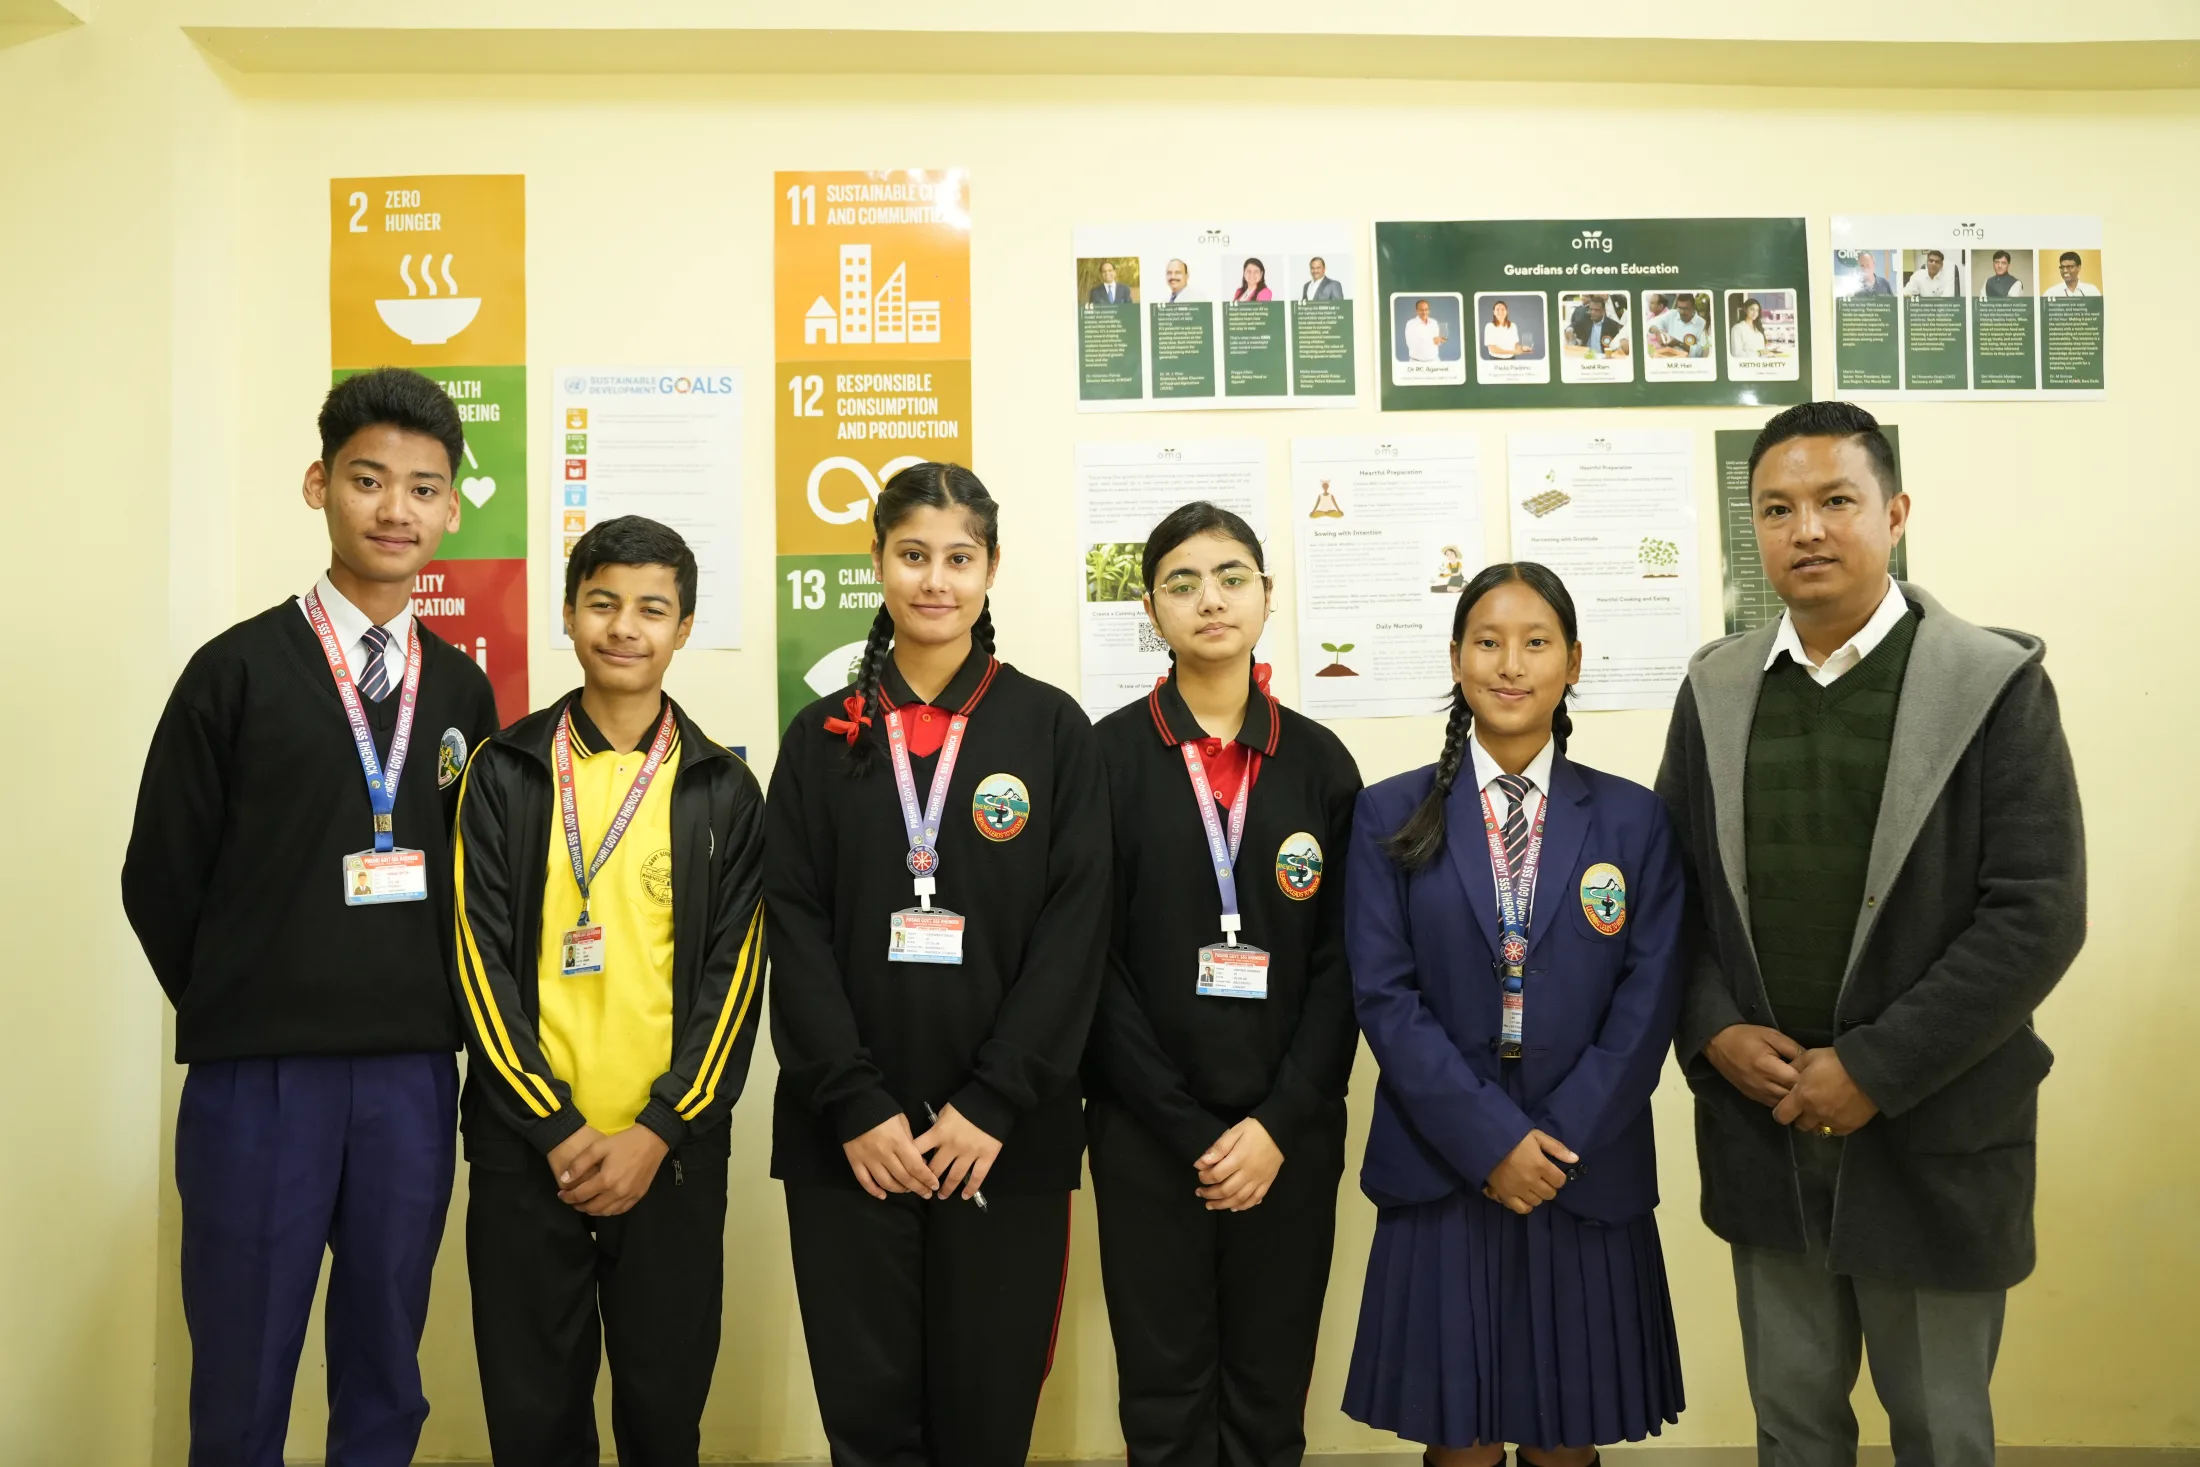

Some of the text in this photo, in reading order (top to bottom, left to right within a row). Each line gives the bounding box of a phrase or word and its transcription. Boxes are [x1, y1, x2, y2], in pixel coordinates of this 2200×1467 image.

[385, 190, 420, 208] ZERO
[827, 184, 916, 202] SUSTAINABLE
[349, 191, 368, 233] 2
[787, 185, 815, 225] 11
[385, 213, 441, 232] HUNGER
[827, 208, 856, 225] AND
[1198, 233, 1231, 247] omg
[1953, 226, 1984, 239] omg
[1571, 236, 1613, 253] omg
[1504, 262, 1679, 276] Guardians of Green Education
[435, 380, 481, 398] EALTH
[589, 386, 657, 395] DEVELOPMENT
[590, 376, 733, 394] SUSTAINABLE GOALS
[837, 374, 933, 392] RESPONSIBLE
[789, 375, 824, 417] 12
[837, 397, 938, 416] CONSUMPTION
[837, 420, 959, 439] AND PRODUCTION
[412, 575, 445, 592] LITY
[839, 569, 883, 585] CLIMA
[787, 569, 826, 609] 13
[322, 633, 343, 666] RHENOCK
[339, 681, 379, 776] PMSHRI GOVT SSS RHENOCK
[401, 706, 413, 737] RHENOCK
[395, 736, 407, 751] SSS
[944, 735, 958, 763] RHENOCK
[390, 747, 403, 770] GOVT
[556, 738, 570, 772] RHENOCK
[643, 748, 662, 775] PMSHRI
[655, 734, 668, 751] GOVT
[895, 743, 907, 772] RHENOCK
[900, 769, 910, 782] SSS
[940, 761, 950, 775] SSS
[1195, 777, 1209, 805] RHENOCK
[907, 803, 918, 828] PMSHRI
[928, 794, 942, 820] PMSHRI
[1204, 804, 1213, 818] SSS
[1235, 802, 1244, 813] SSS
[561, 787, 584, 879] PMSHRI GOVT SSS RHENOCK
[591, 787, 644, 873] PMSHRI GOVT SSS RHENOCK
[1212, 837, 1225, 862] PMSHRI
[1528, 836, 1542, 865] RHENOCK
[1488, 833, 1516, 926] PMSHRI GOVT SSS RHENOCK
[1524, 865, 1535, 878] SSS
[1520, 878, 1531, 897] GOVT
